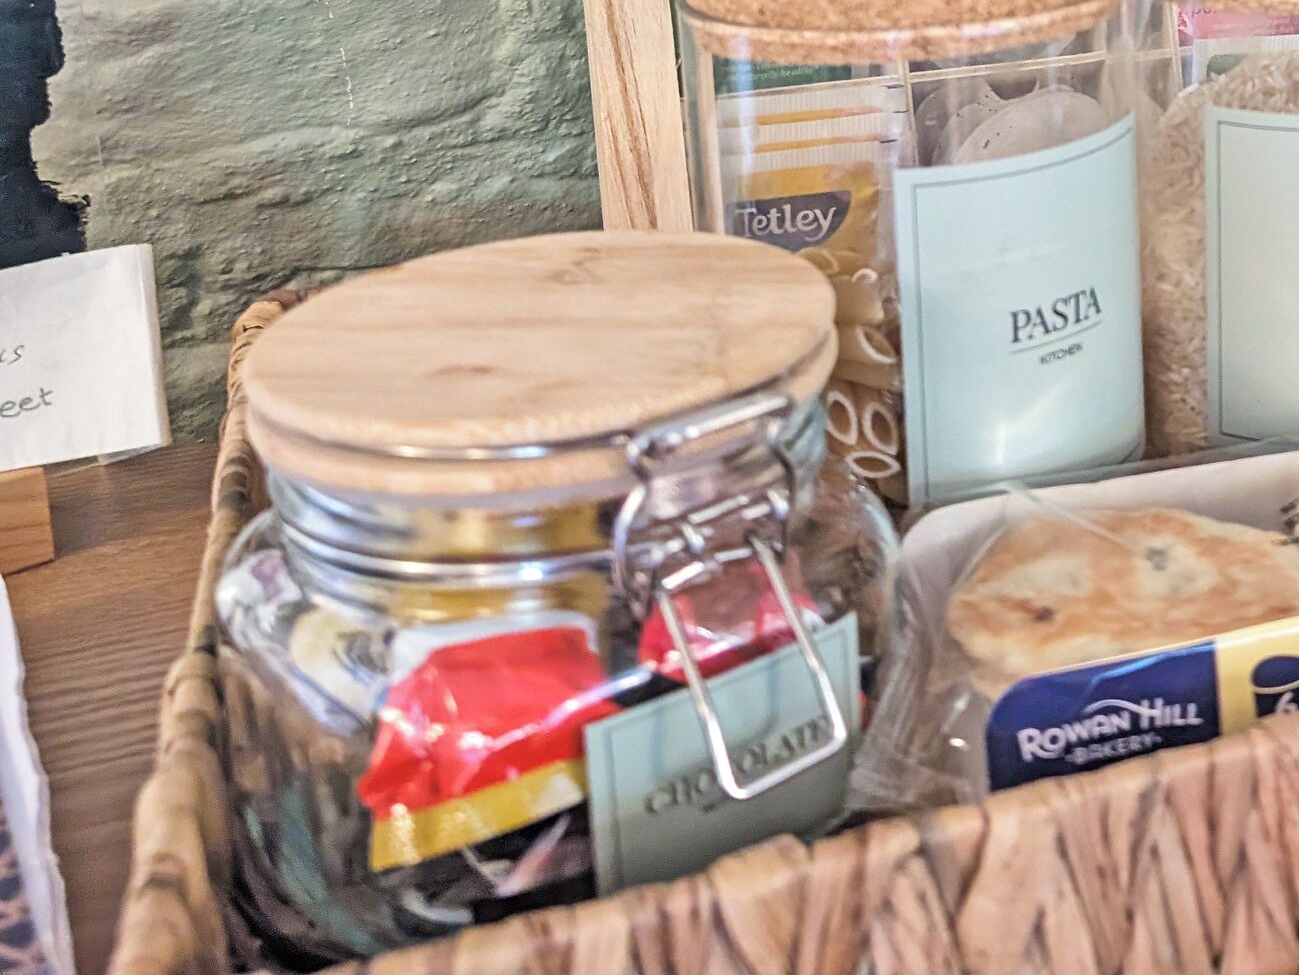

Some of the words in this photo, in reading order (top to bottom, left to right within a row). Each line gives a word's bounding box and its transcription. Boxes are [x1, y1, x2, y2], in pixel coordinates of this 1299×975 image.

[735, 204, 837, 242] Tetley
[1010, 286, 1103, 344] PASTA
[1017, 708, 1132, 763] ROWAN
[1139, 697, 1204, 727] HILL
